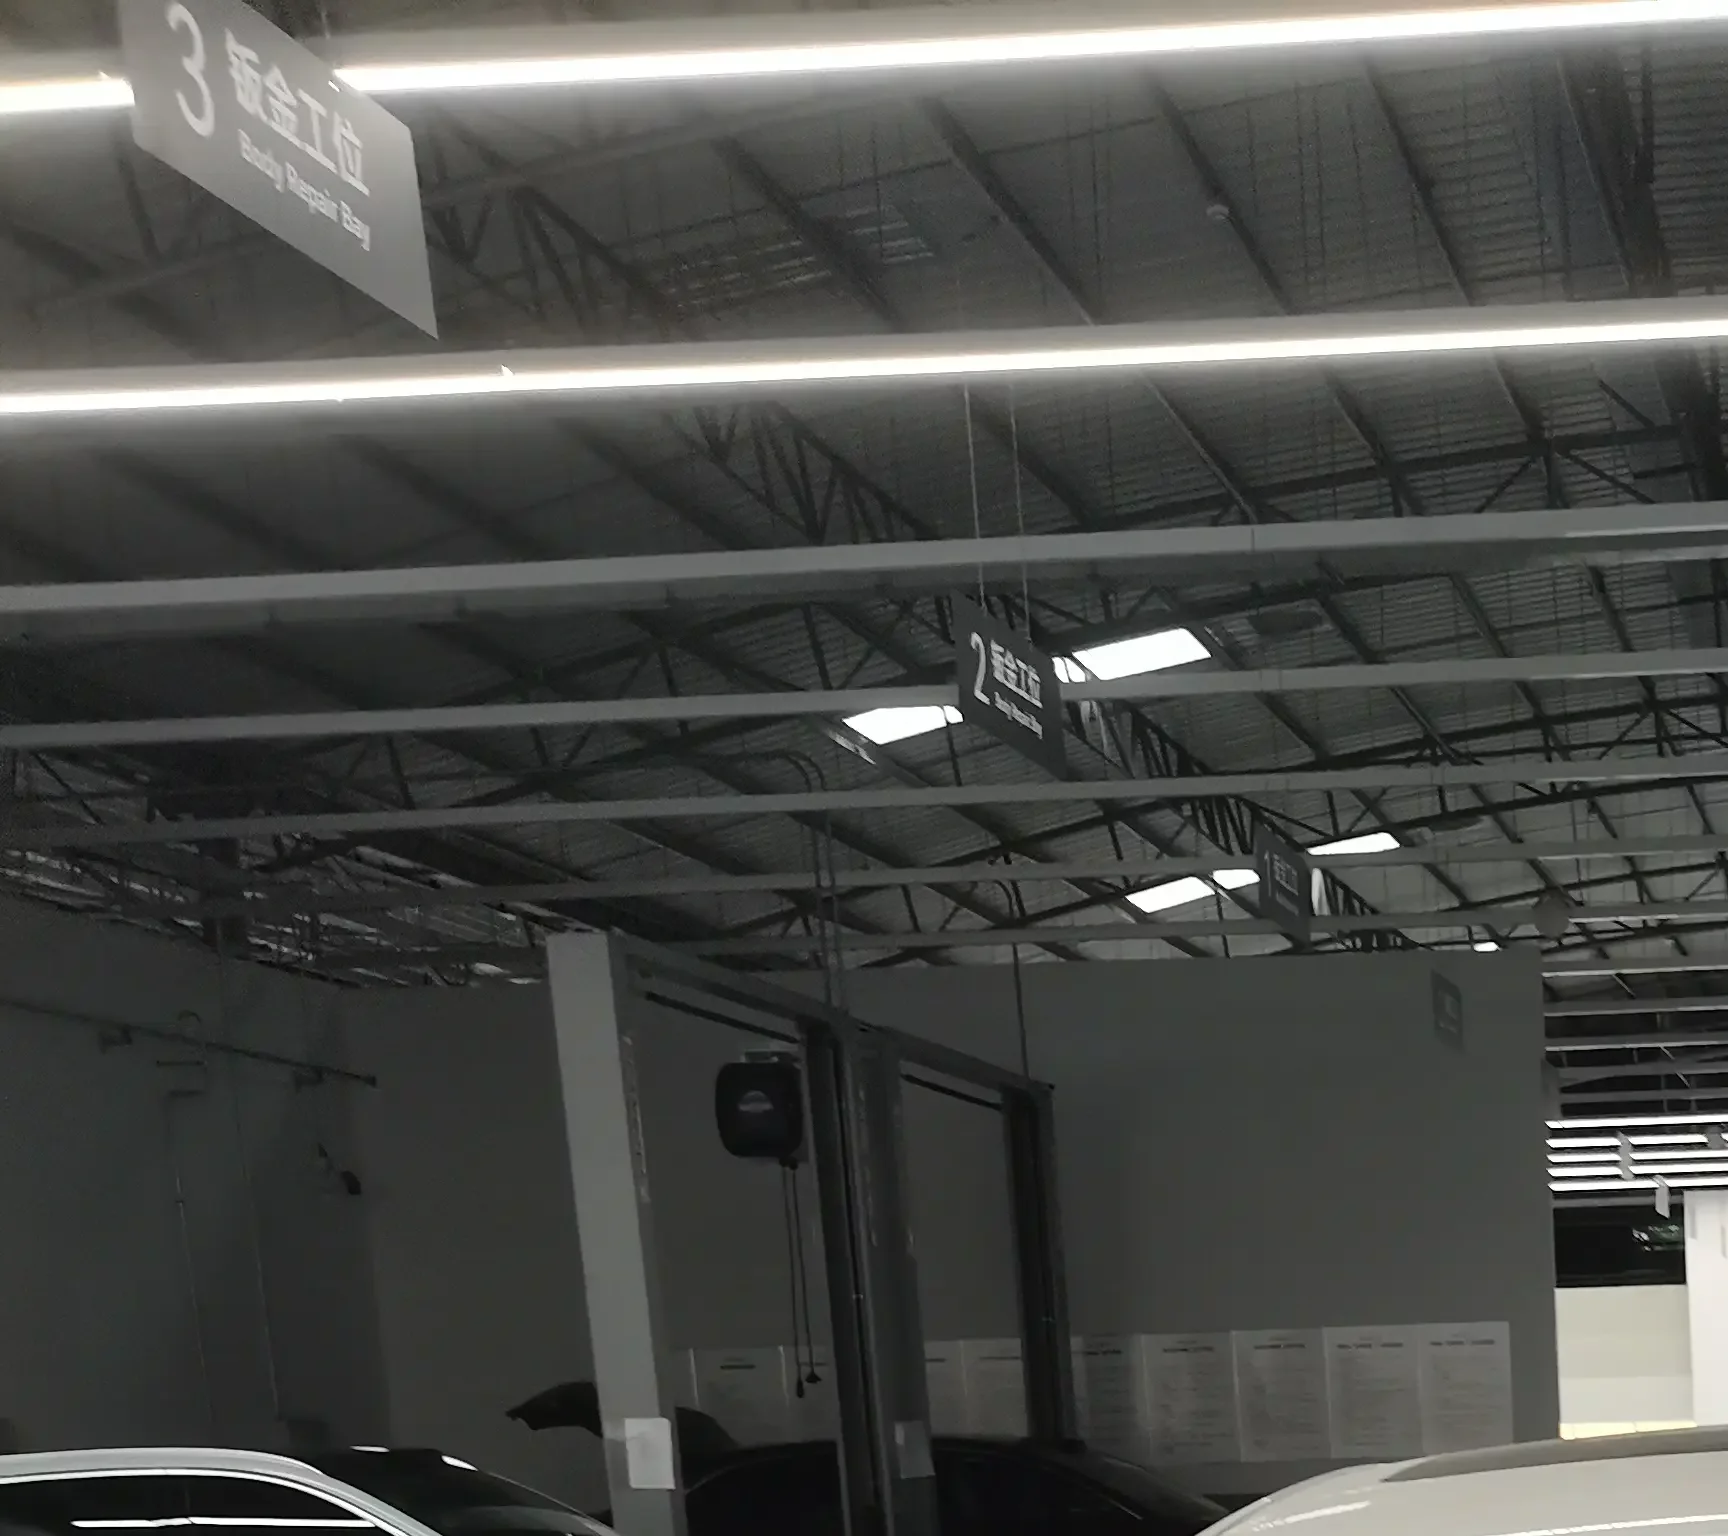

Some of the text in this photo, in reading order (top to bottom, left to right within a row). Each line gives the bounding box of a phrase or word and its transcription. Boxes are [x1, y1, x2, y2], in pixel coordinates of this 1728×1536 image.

[165, 2, 371, 198] 3 钣金工位
[970, 631, 991, 706] 2
